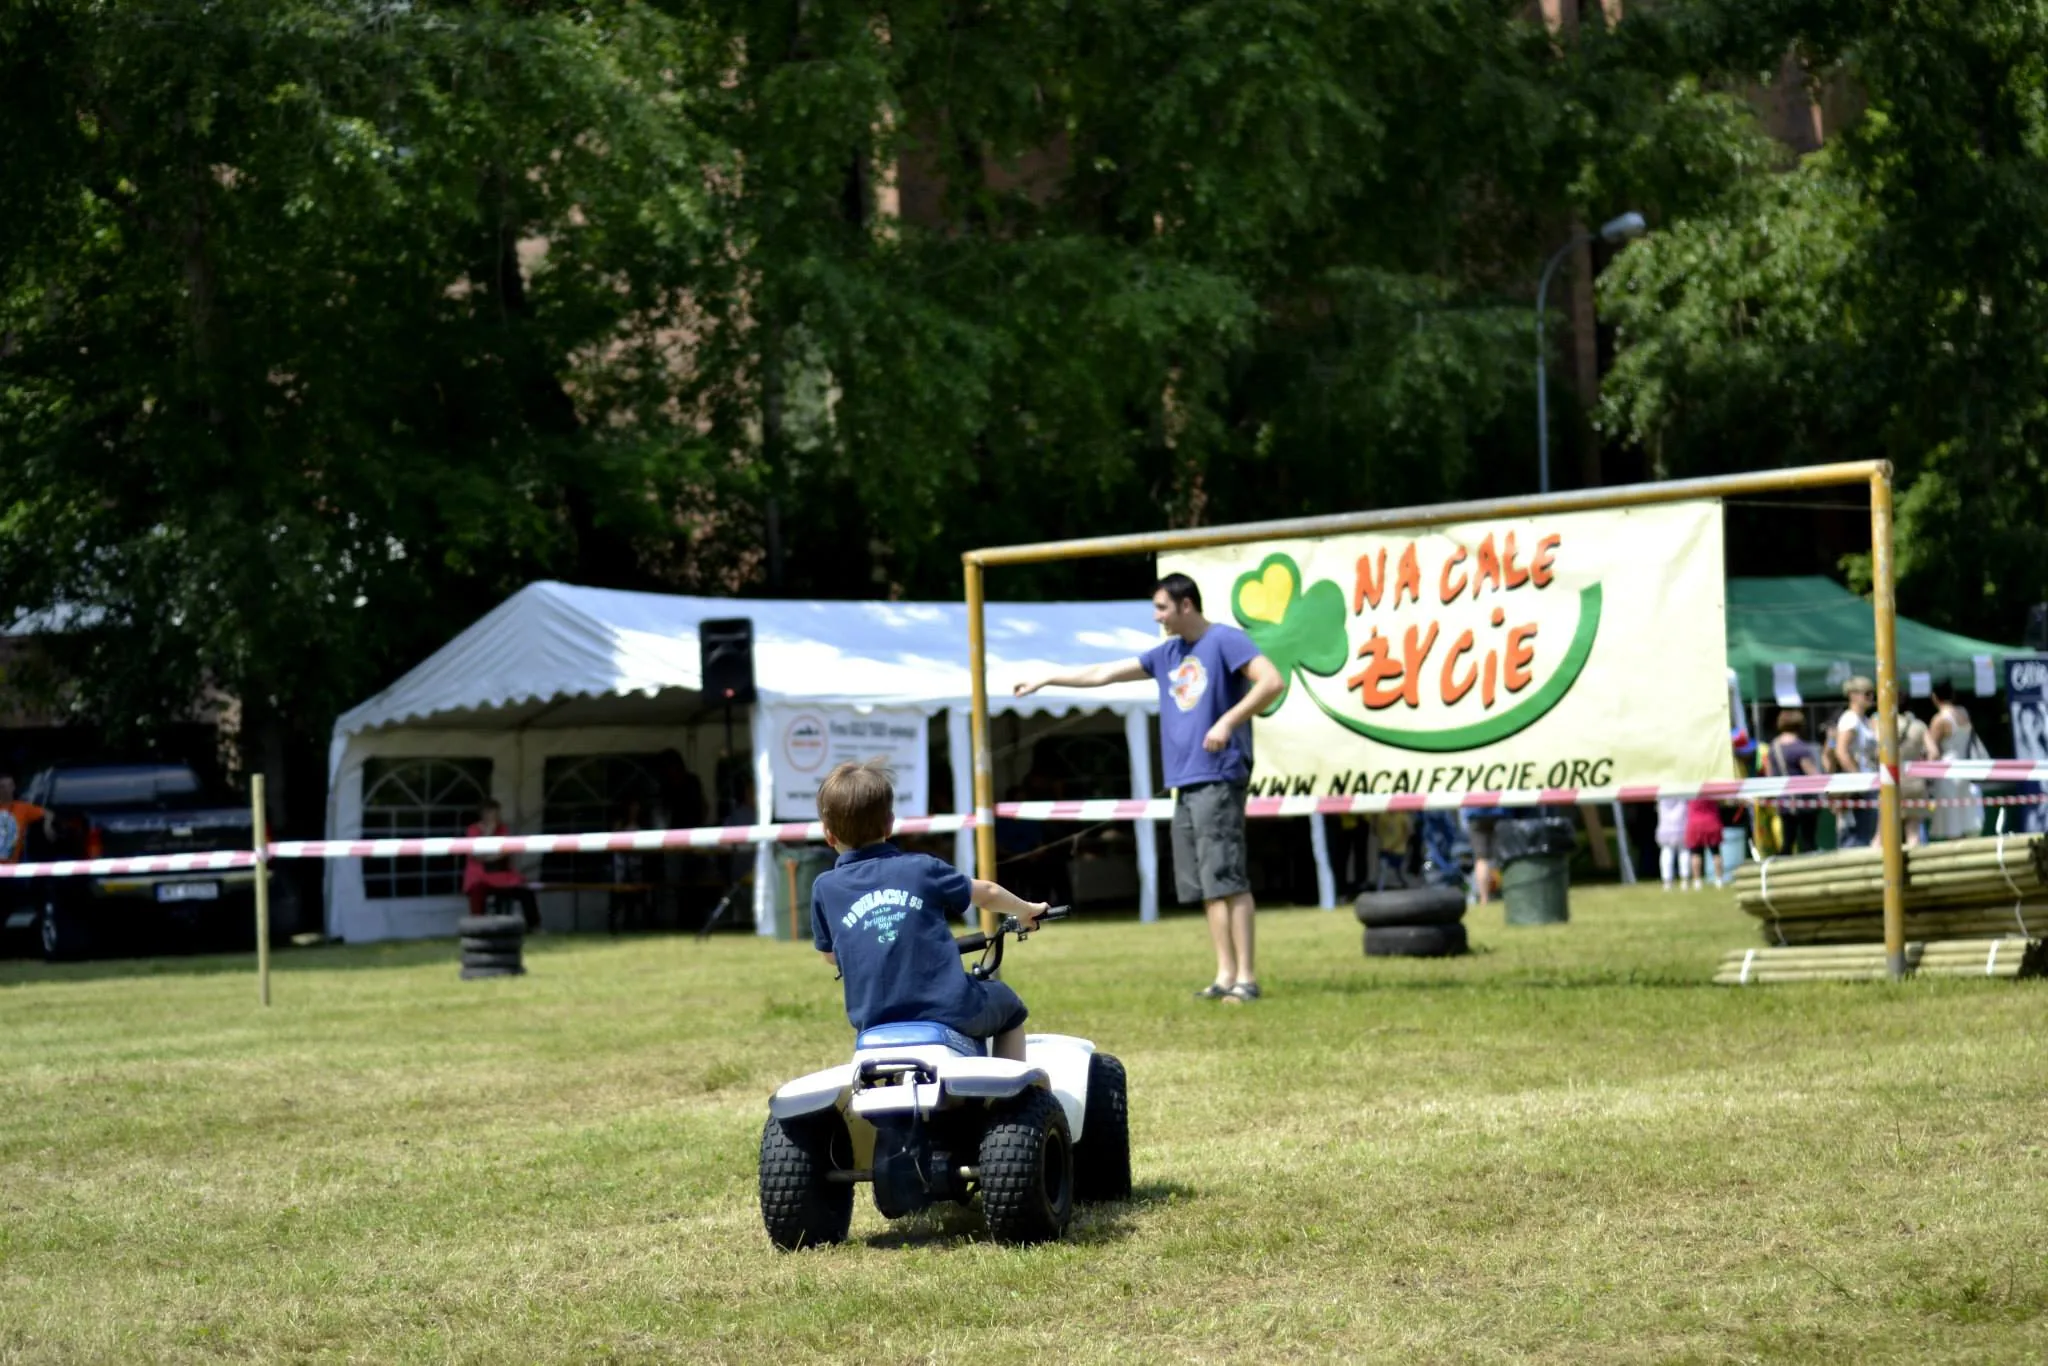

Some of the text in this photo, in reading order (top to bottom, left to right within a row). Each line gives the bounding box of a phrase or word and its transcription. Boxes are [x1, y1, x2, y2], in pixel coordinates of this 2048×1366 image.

[1354, 530, 1562, 616] NA CAŁE
[1247, 757, 1614, 797] WWWNACALEZYCIE.ORG
